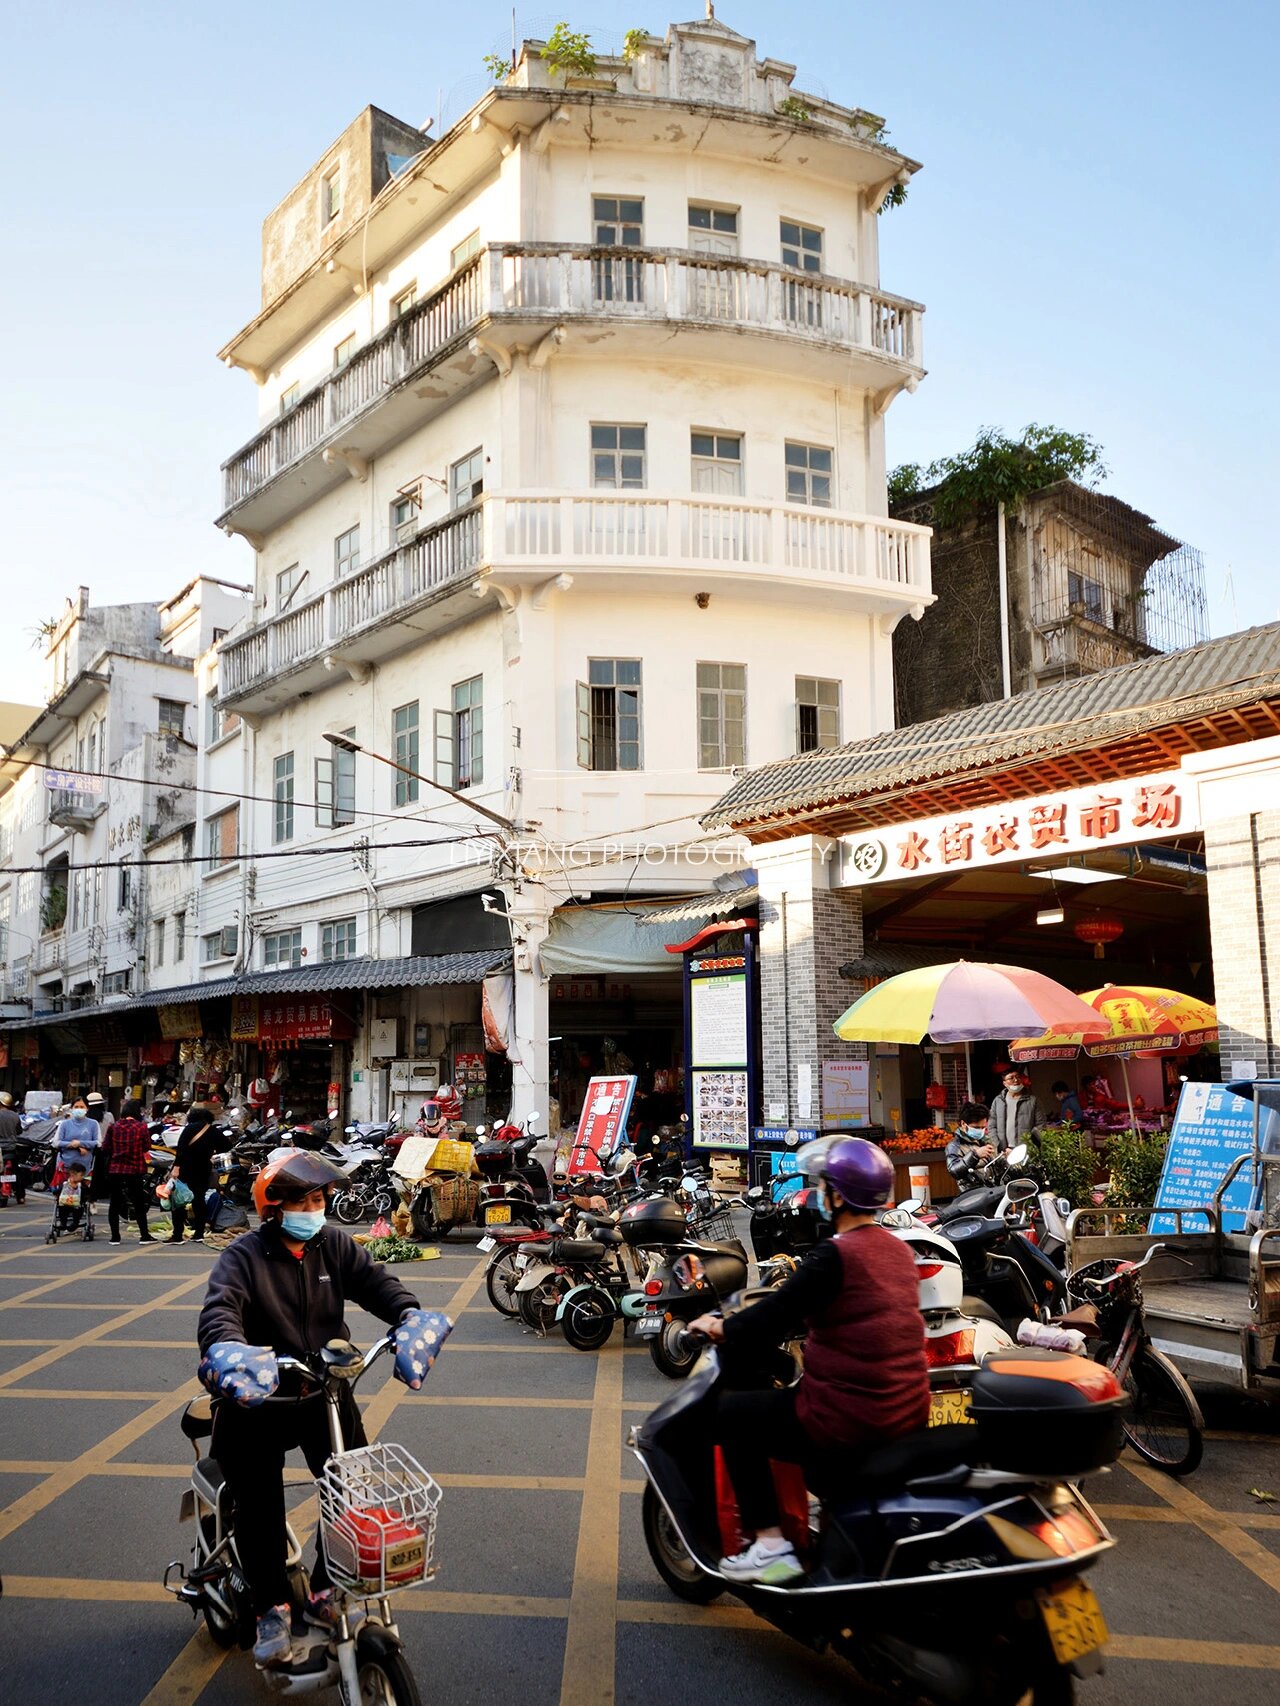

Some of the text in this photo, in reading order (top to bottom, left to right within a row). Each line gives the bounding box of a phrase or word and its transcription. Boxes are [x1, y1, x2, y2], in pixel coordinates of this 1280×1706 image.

[896, 784, 1182, 871] 水街农贸市场
[1207, 1093, 1247, 1113] 通告
